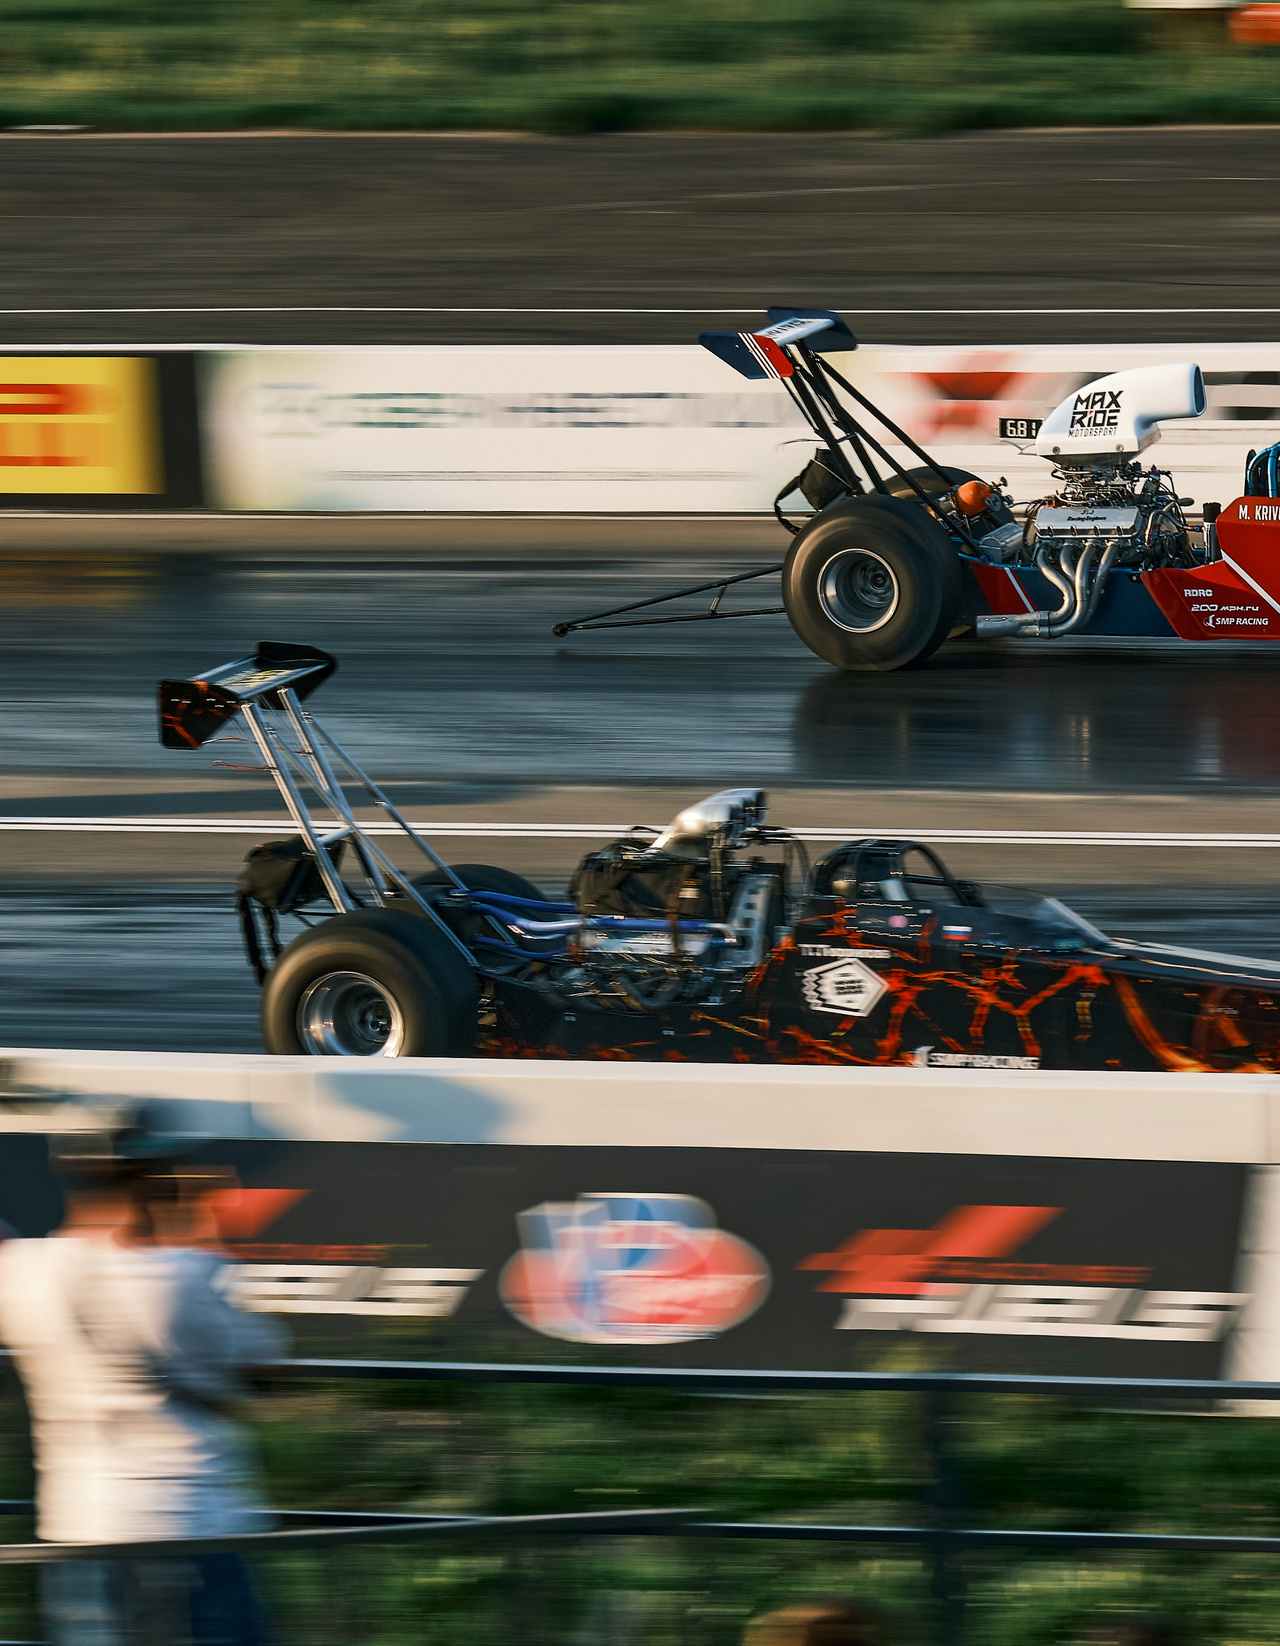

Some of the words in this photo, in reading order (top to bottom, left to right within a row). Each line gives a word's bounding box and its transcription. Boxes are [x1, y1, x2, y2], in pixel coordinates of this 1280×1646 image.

[1073, 390, 1124, 410] MAX
[1068, 427, 1118, 437] MOTORSPORT
[1238, 504, 1251, 521] M.
[1183, 588, 1213, 598] RDRC
[1215, 617, 1236, 626] SMP
[1235, 617, 1269, 626] RACING
